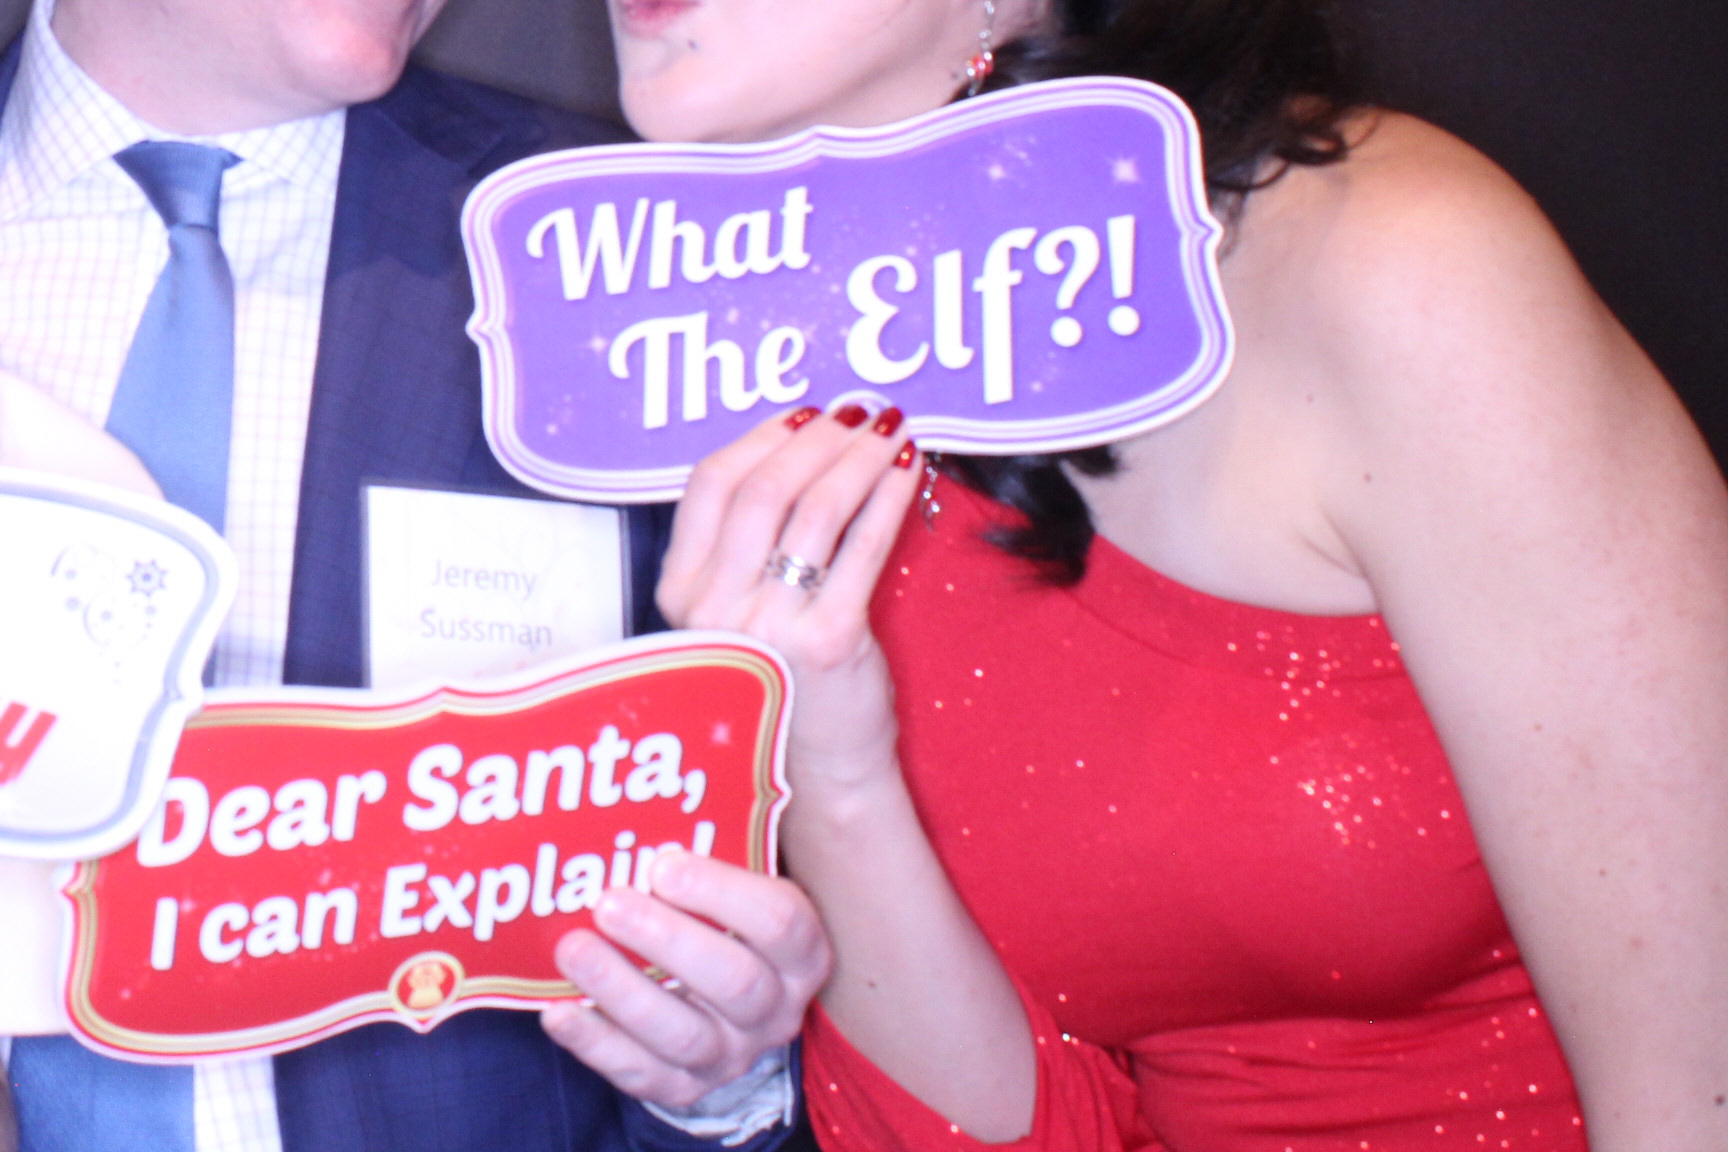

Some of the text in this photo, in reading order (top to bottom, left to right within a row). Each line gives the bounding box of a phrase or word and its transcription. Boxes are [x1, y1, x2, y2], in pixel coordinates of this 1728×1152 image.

[526, 186, 813, 301] What
[608, 214, 1141, 429] The Elf?!
[420, 607, 553, 648] Sussman
[431, 558, 538, 602] Jeremy
[136, 724, 707, 868] Dear Santa,
[150, 896, 178, 970] I
[198, 882, 359, 963] can
